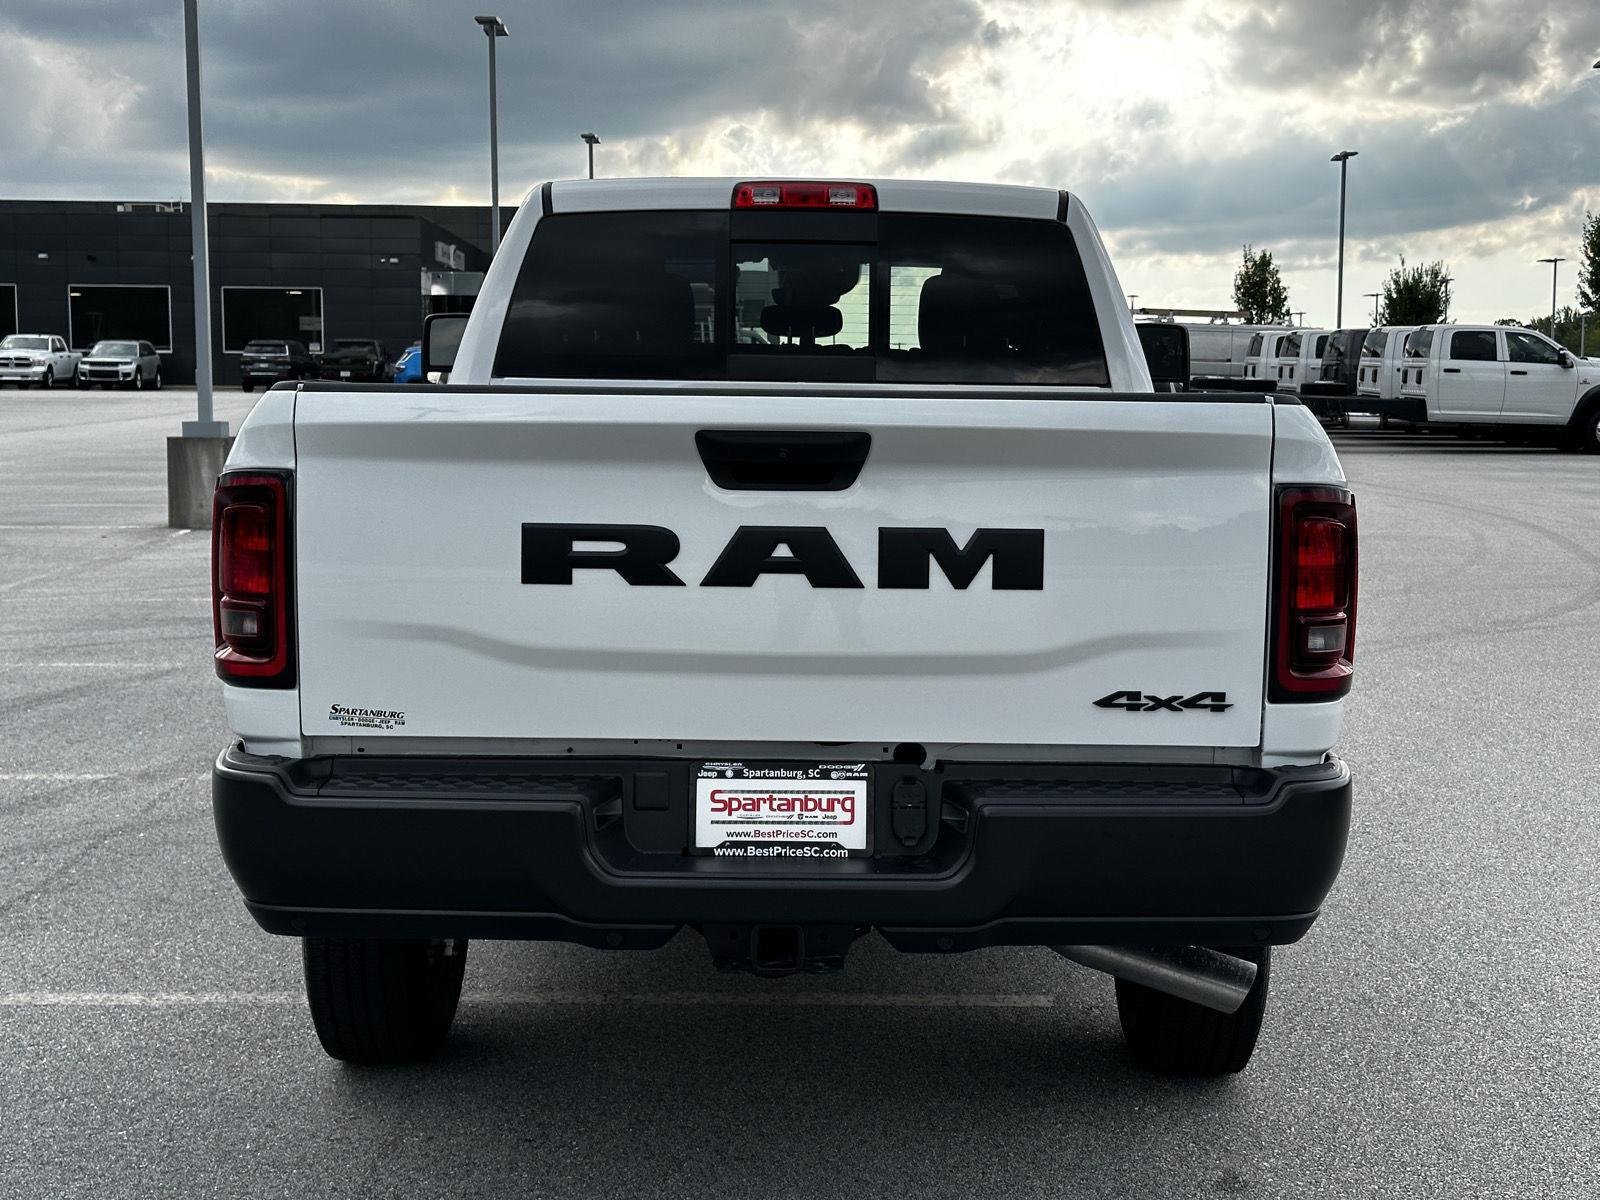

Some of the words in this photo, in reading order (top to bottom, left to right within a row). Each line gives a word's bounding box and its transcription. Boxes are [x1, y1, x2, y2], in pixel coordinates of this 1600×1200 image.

[521, 522, 1045, 590] RAM
[1092, 690, 1234, 712] 4x4
[329, 703, 405, 719] SPARTANBURG
[697, 770, 718, 778] Jeep
[743, 769, 807, 780] Spartanburg,
[808, 769, 821, 779] SC
[710, 789, 856, 826] Spartanburg
[726, 829, 838, 839] www.BestPriceSC.com
[714, 846, 849, 858] www.BestPriceSC.com
